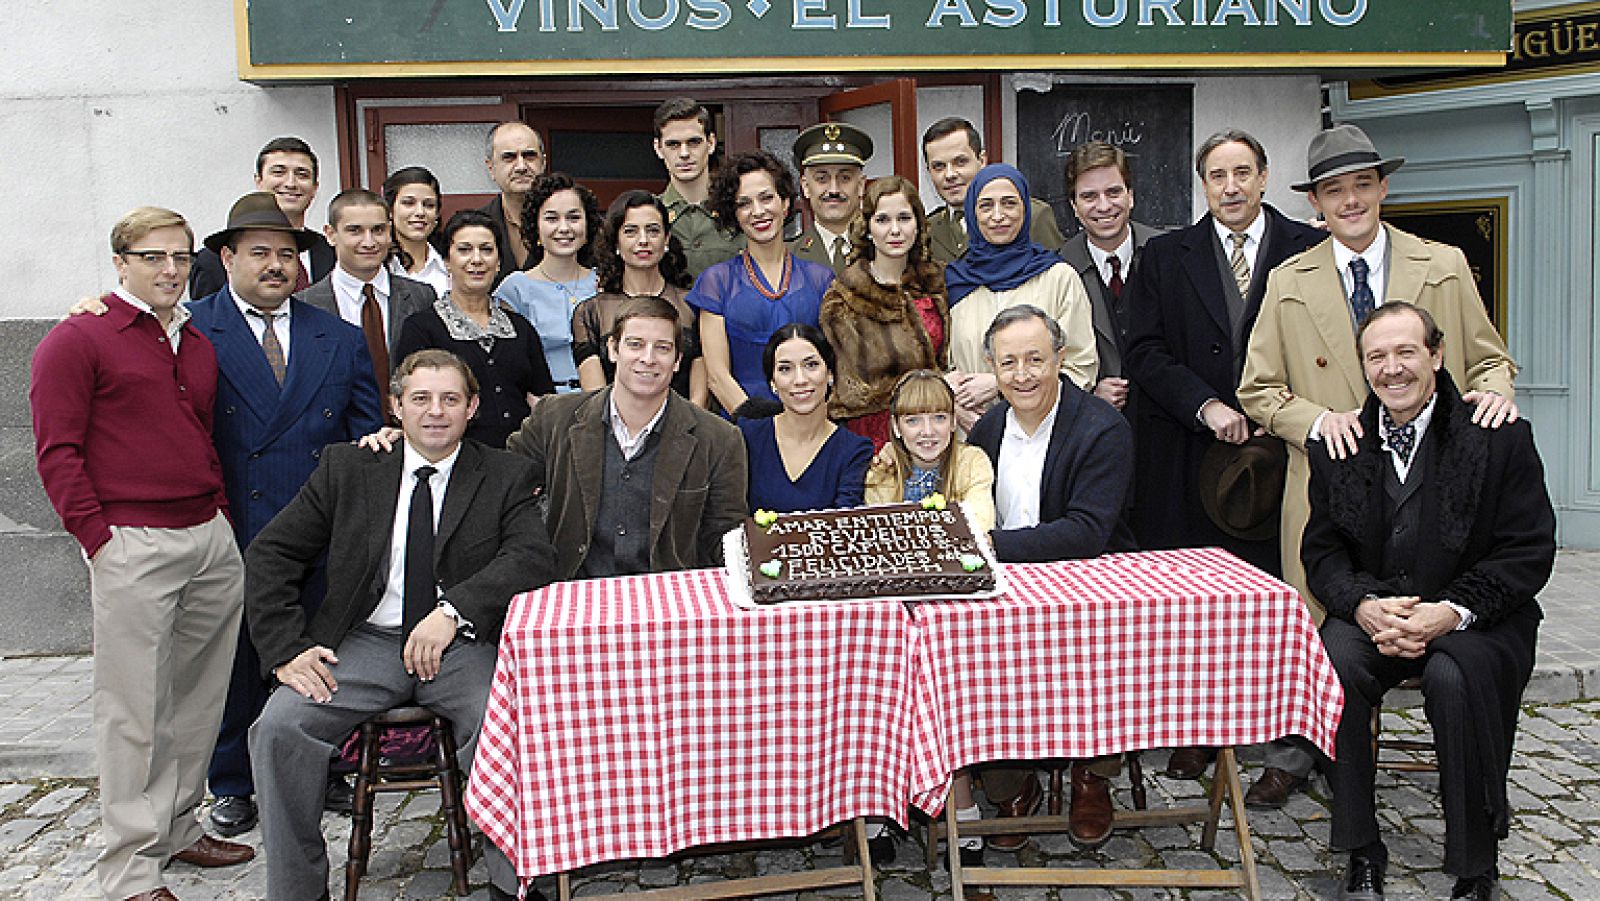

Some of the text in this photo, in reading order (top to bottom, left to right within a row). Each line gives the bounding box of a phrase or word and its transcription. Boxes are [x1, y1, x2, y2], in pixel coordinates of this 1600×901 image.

[486, 0, 1368, 32] VINOS EL ASTURIANO
[766, 518, 832, 535] AMAR
[808, 525, 948, 545] REVUELTOS
[771, 543, 824, 558] 1500
